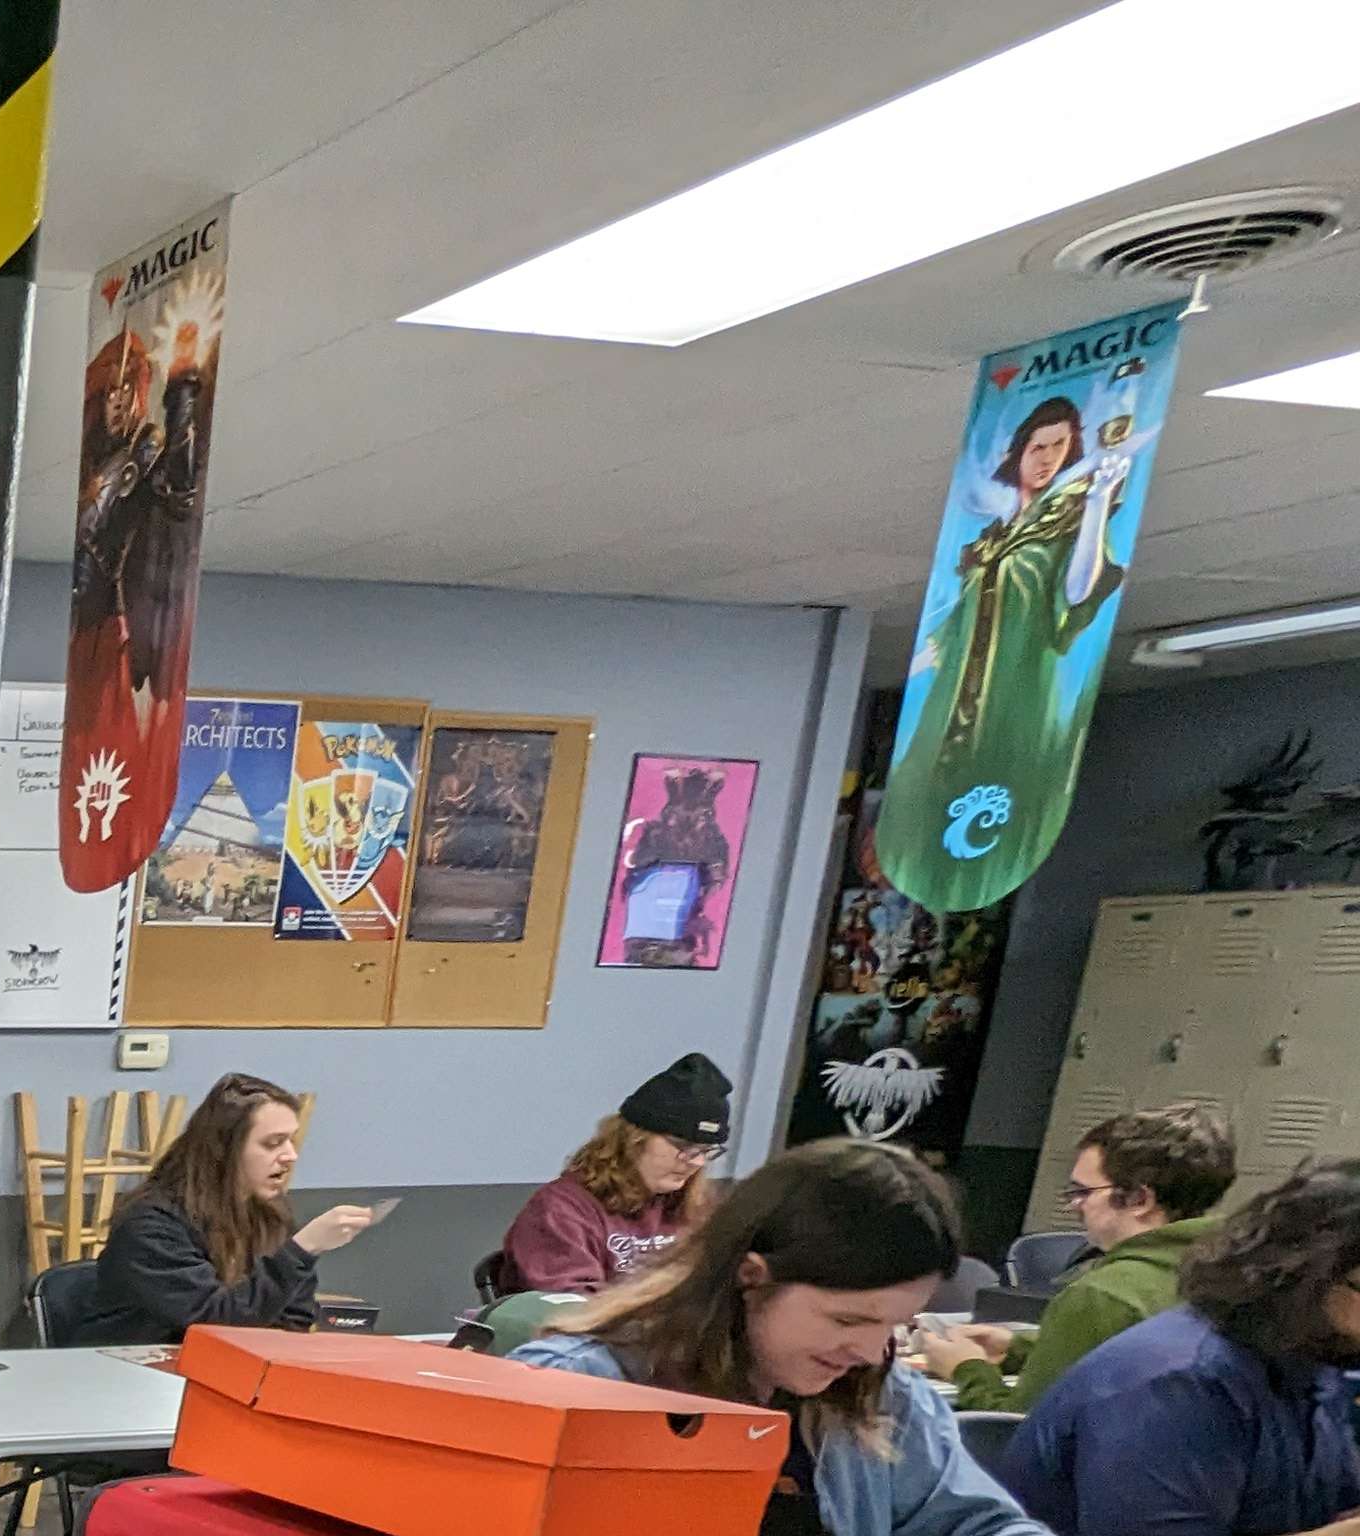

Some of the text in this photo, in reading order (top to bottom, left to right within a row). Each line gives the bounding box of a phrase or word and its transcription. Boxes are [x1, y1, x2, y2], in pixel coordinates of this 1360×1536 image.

[122, 217, 219, 297] MAGIC
[1023, 318, 1168, 383] MAGIC
[182, 723, 288, 750] RCHITECTS
